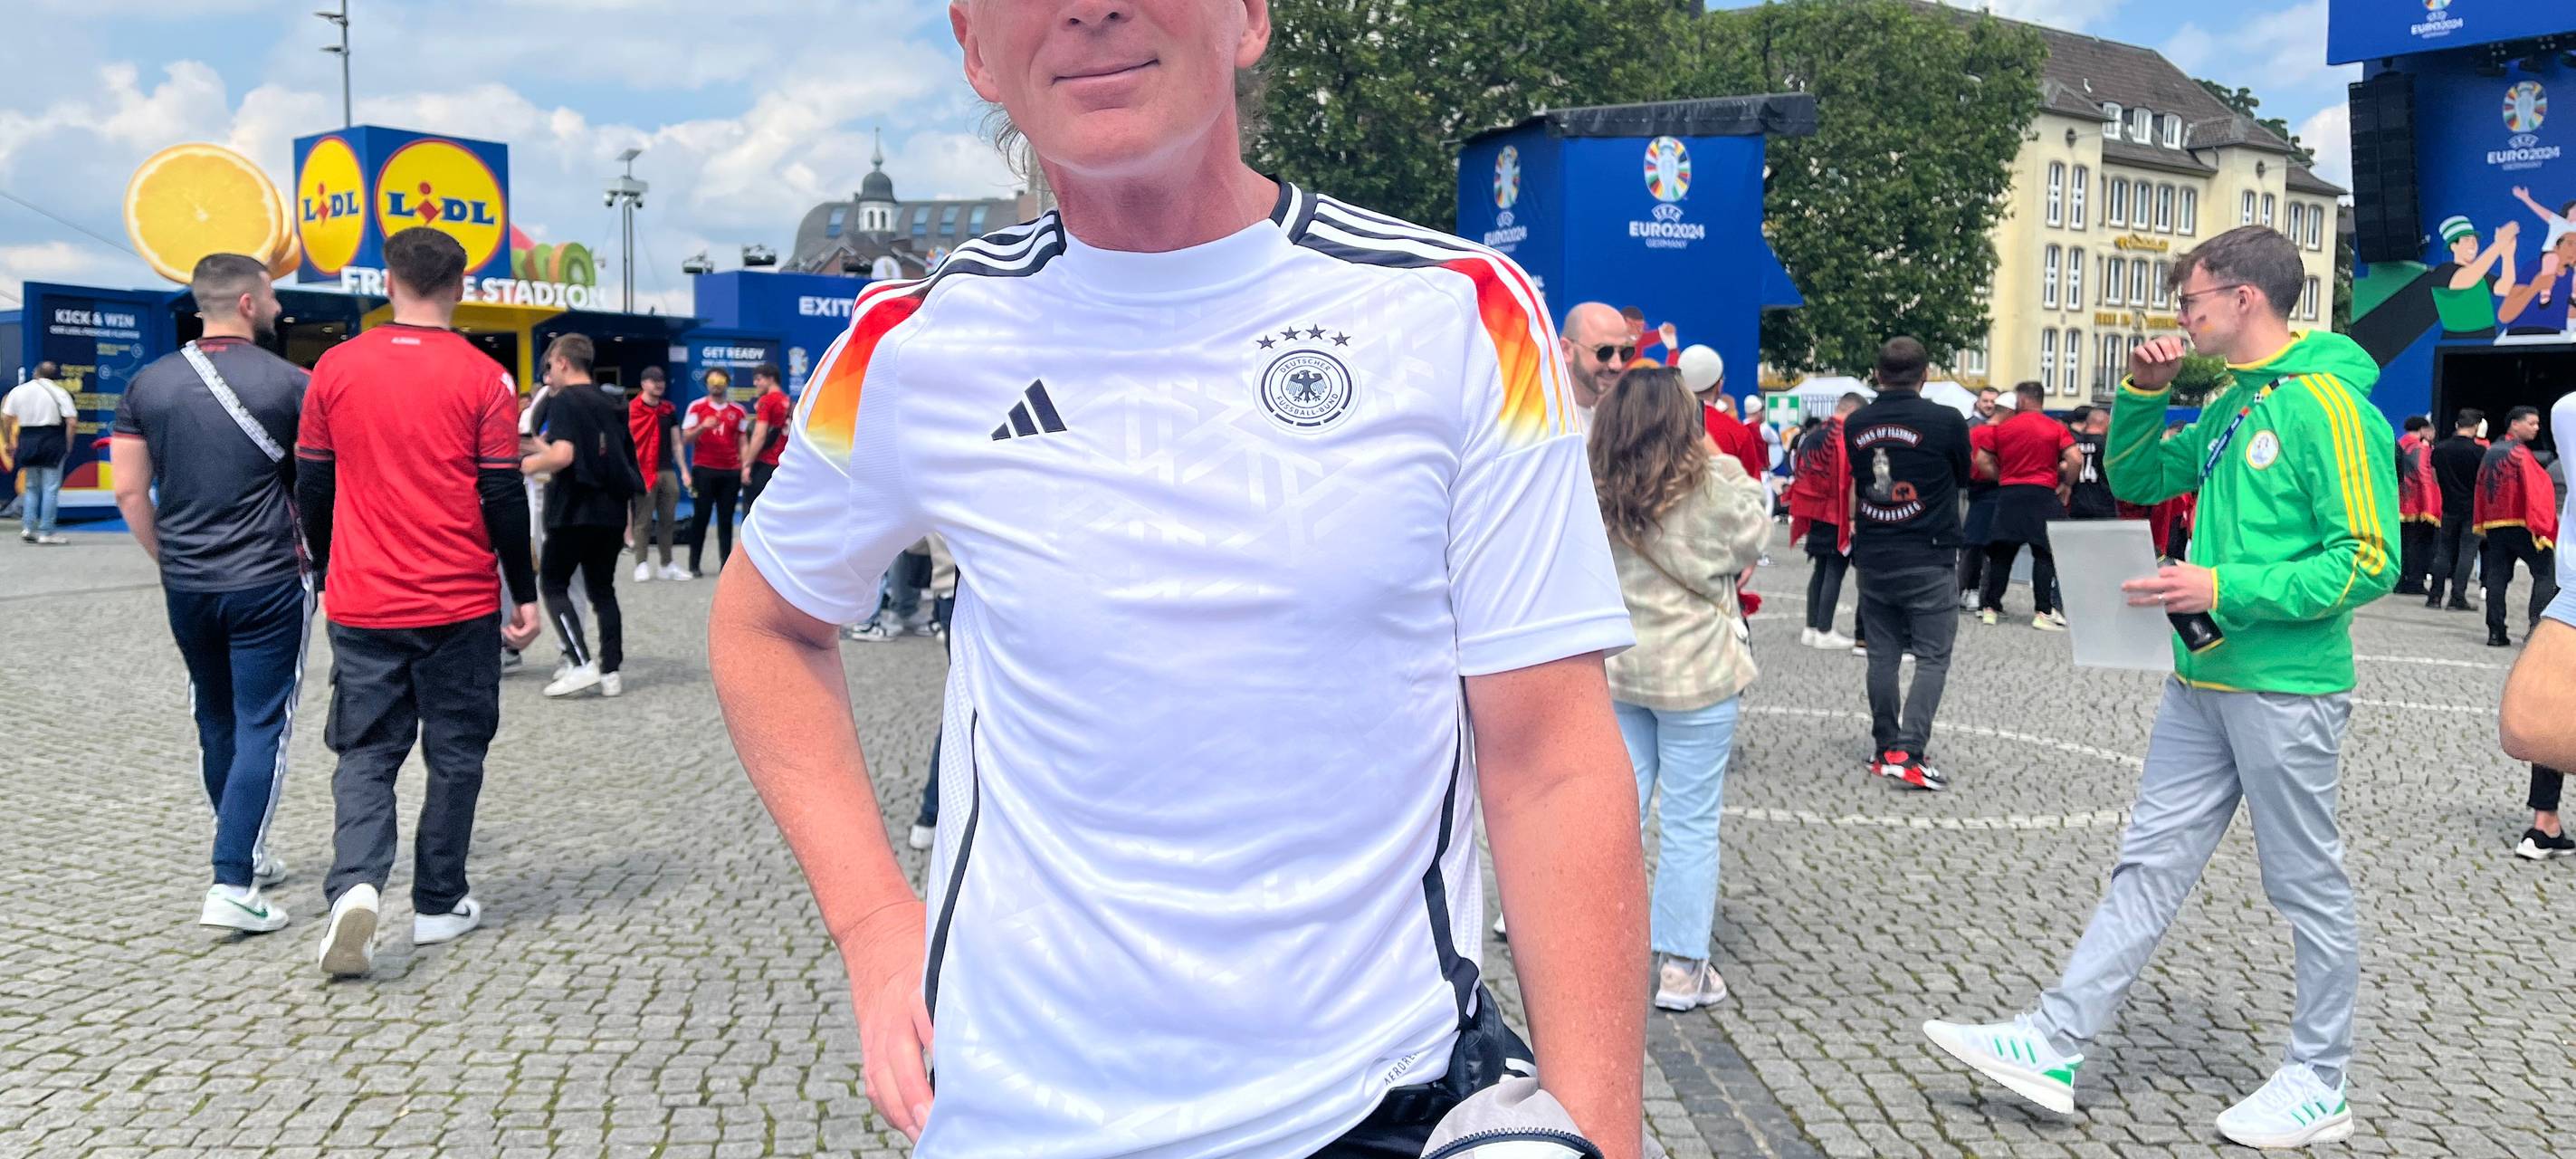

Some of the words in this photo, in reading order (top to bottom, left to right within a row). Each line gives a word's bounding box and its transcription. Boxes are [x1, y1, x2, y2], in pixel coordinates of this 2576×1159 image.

[482, 276, 607, 311] STADION
[799, 296, 854, 317] EXIT
[55, 309, 91, 325] KICK
[104, 312, 135, 328] WIN
[702, 346, 724, 359] GET
[727, 347, 765, 360] READY
[1280, 359, 1331, 373] DEUTSCHER
[1276, 393, 1339, 416] FUSSBALL-BUND
[1856, 429, 1875, 447] SONS
[1876, 426, 1886, 438] OF
